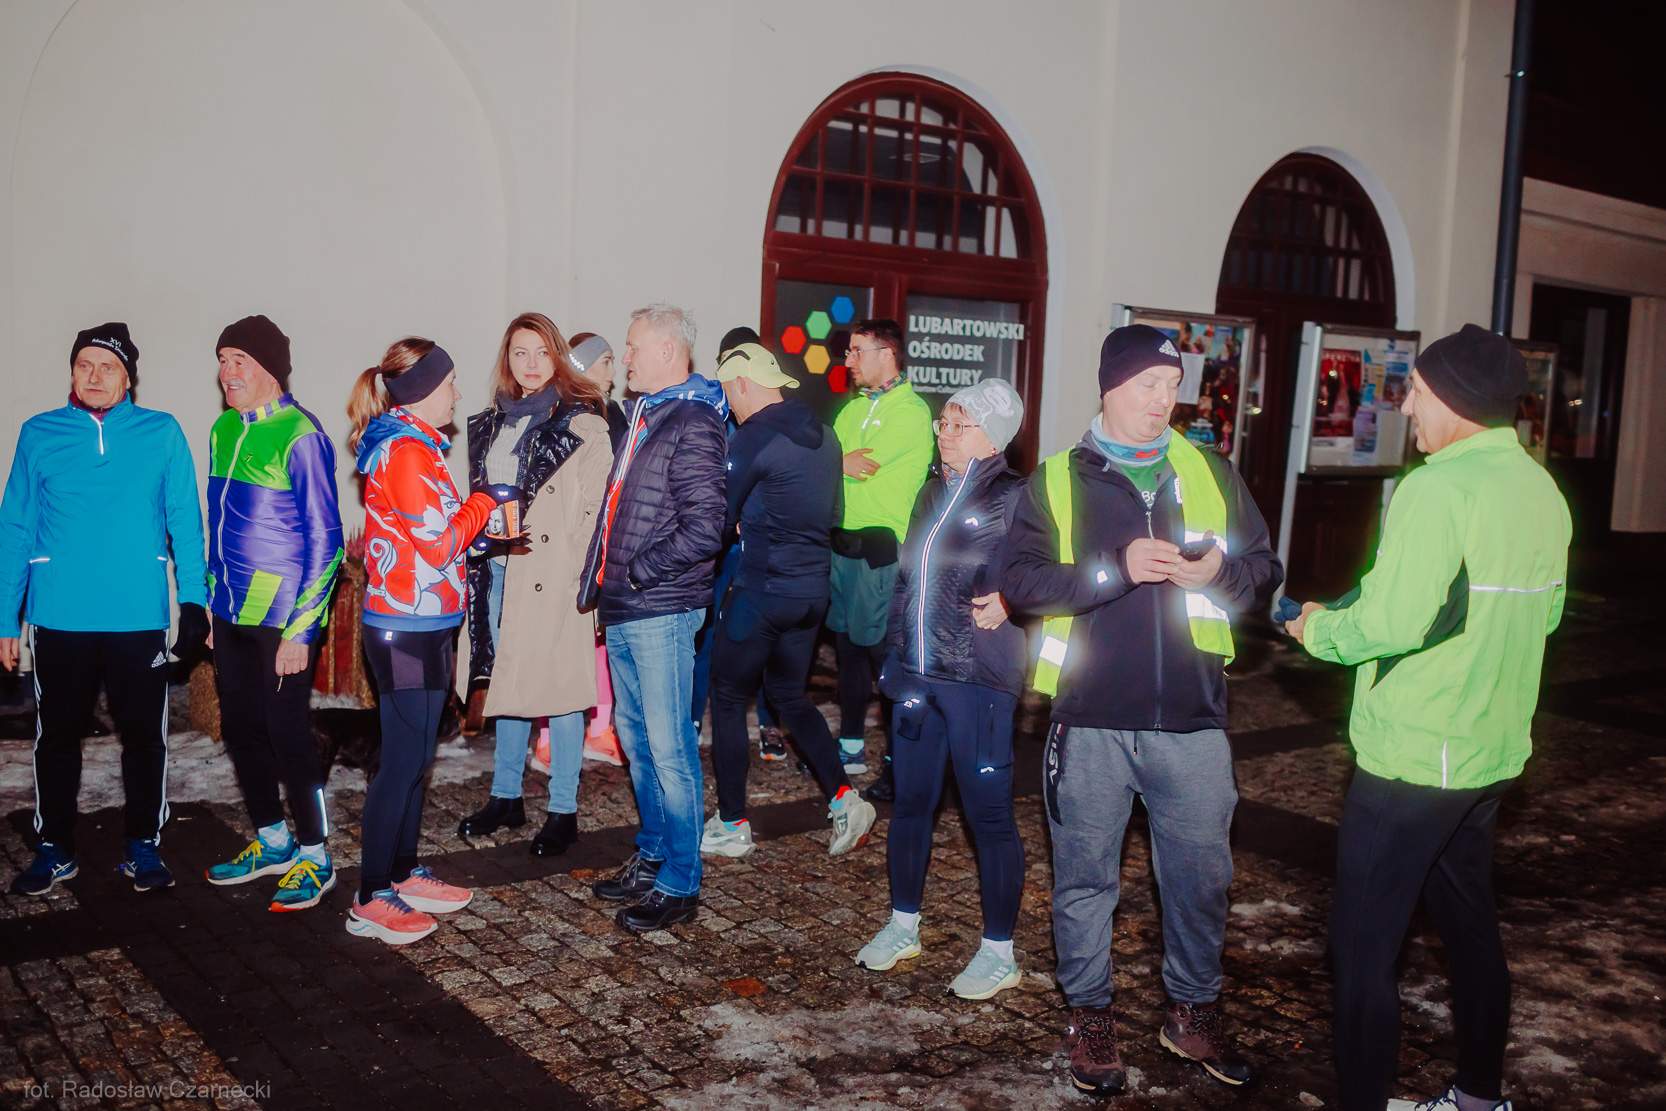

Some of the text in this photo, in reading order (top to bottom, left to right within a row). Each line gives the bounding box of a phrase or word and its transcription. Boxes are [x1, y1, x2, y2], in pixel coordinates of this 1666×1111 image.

[908, 315, 1024, 340] LUBARTOWSKI
[907, 336, 984, 362] OŚRODEK
[906, 366, 982, 386] KULTURY
